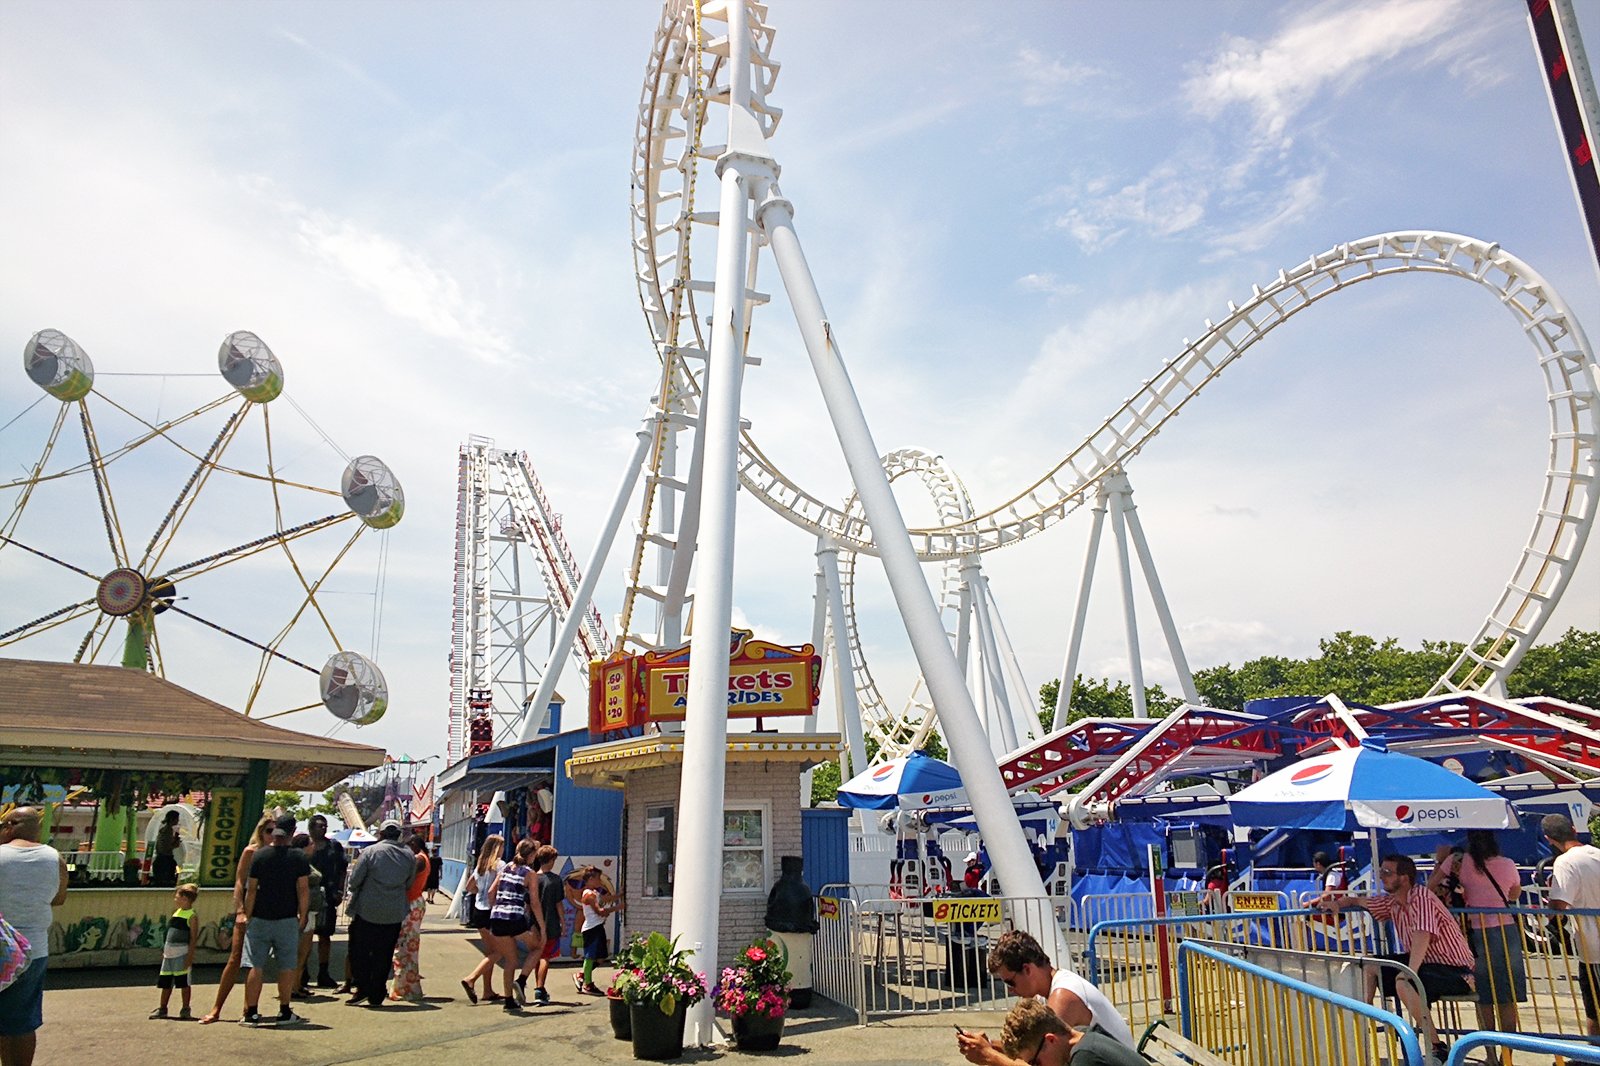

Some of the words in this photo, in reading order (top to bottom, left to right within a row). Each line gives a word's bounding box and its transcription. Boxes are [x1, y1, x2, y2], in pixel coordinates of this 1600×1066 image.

[662, 670, 793, 694] Tets
[934, 792, 957, 804] pepsi
[215, 796, 238, 840] FROG
[1417, 806, 1459, 822] pepsi
[1571, 803, 1584, 818] 17
[209, 845, 231, 879] BOG
[1236, 896, 1274, 905] ENTER
[934, 903, 950, 920] 8
[950, 903, 999, 920] TICKETS
